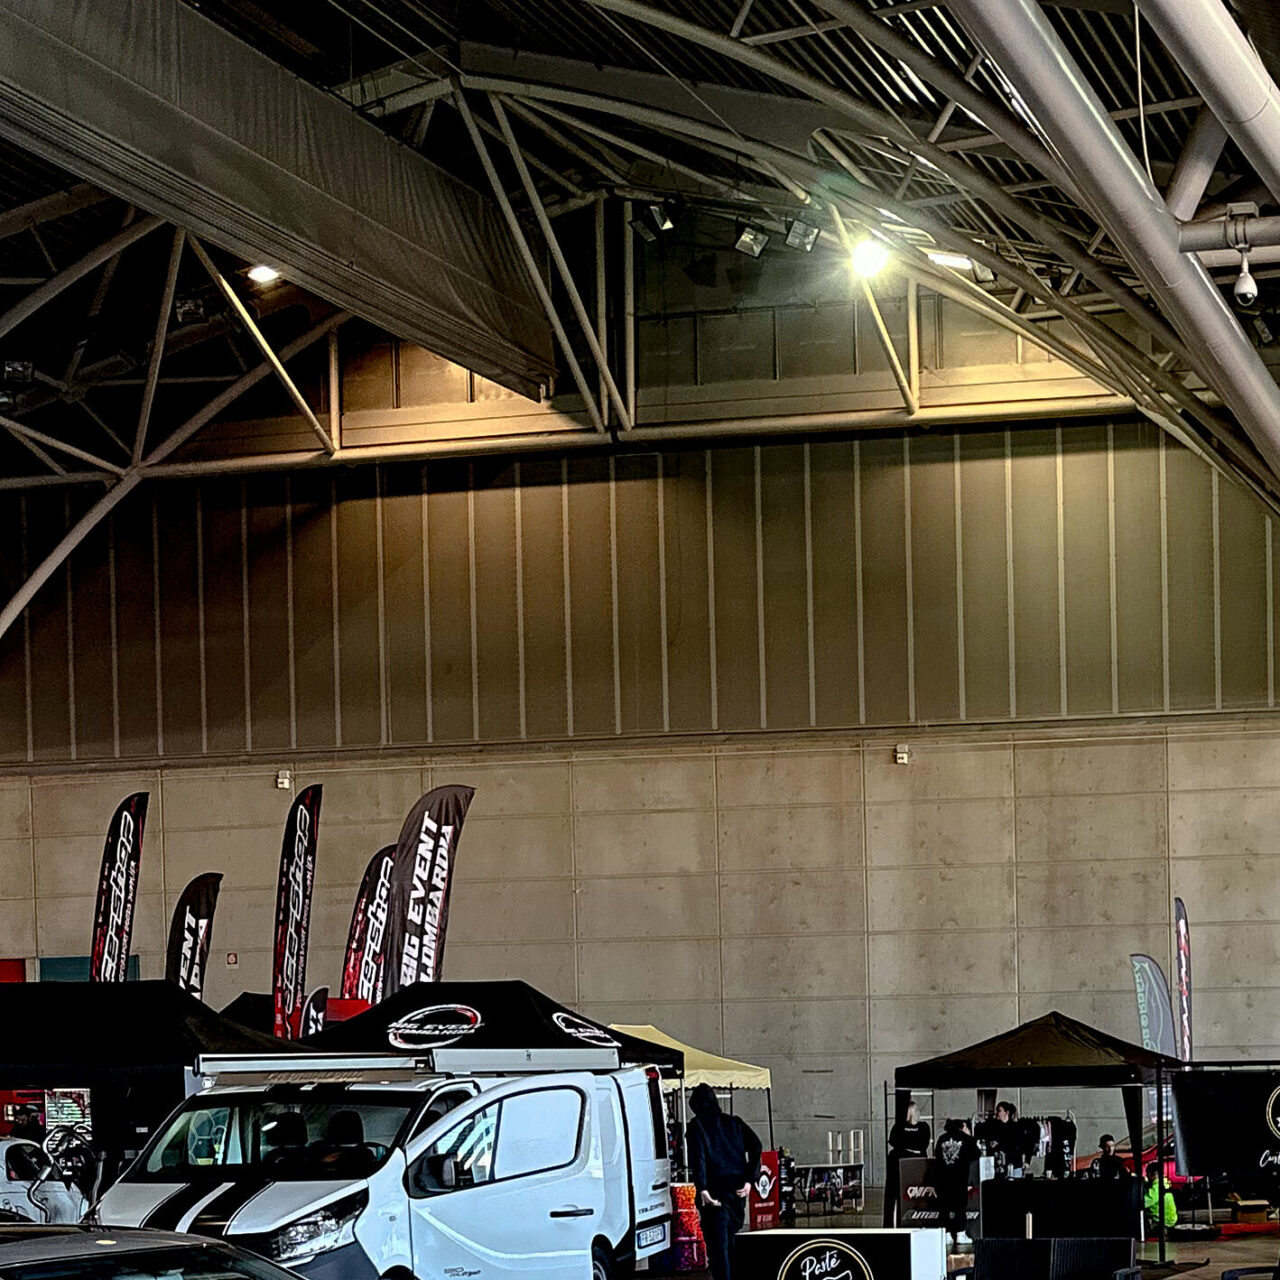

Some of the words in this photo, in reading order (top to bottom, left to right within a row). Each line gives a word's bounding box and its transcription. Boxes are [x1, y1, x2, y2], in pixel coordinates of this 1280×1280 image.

[408, 810, 438, 925] EVENT
[420, 825, 454, 982] LOMBARDIA
[400, 933, 420, 985] BIG
